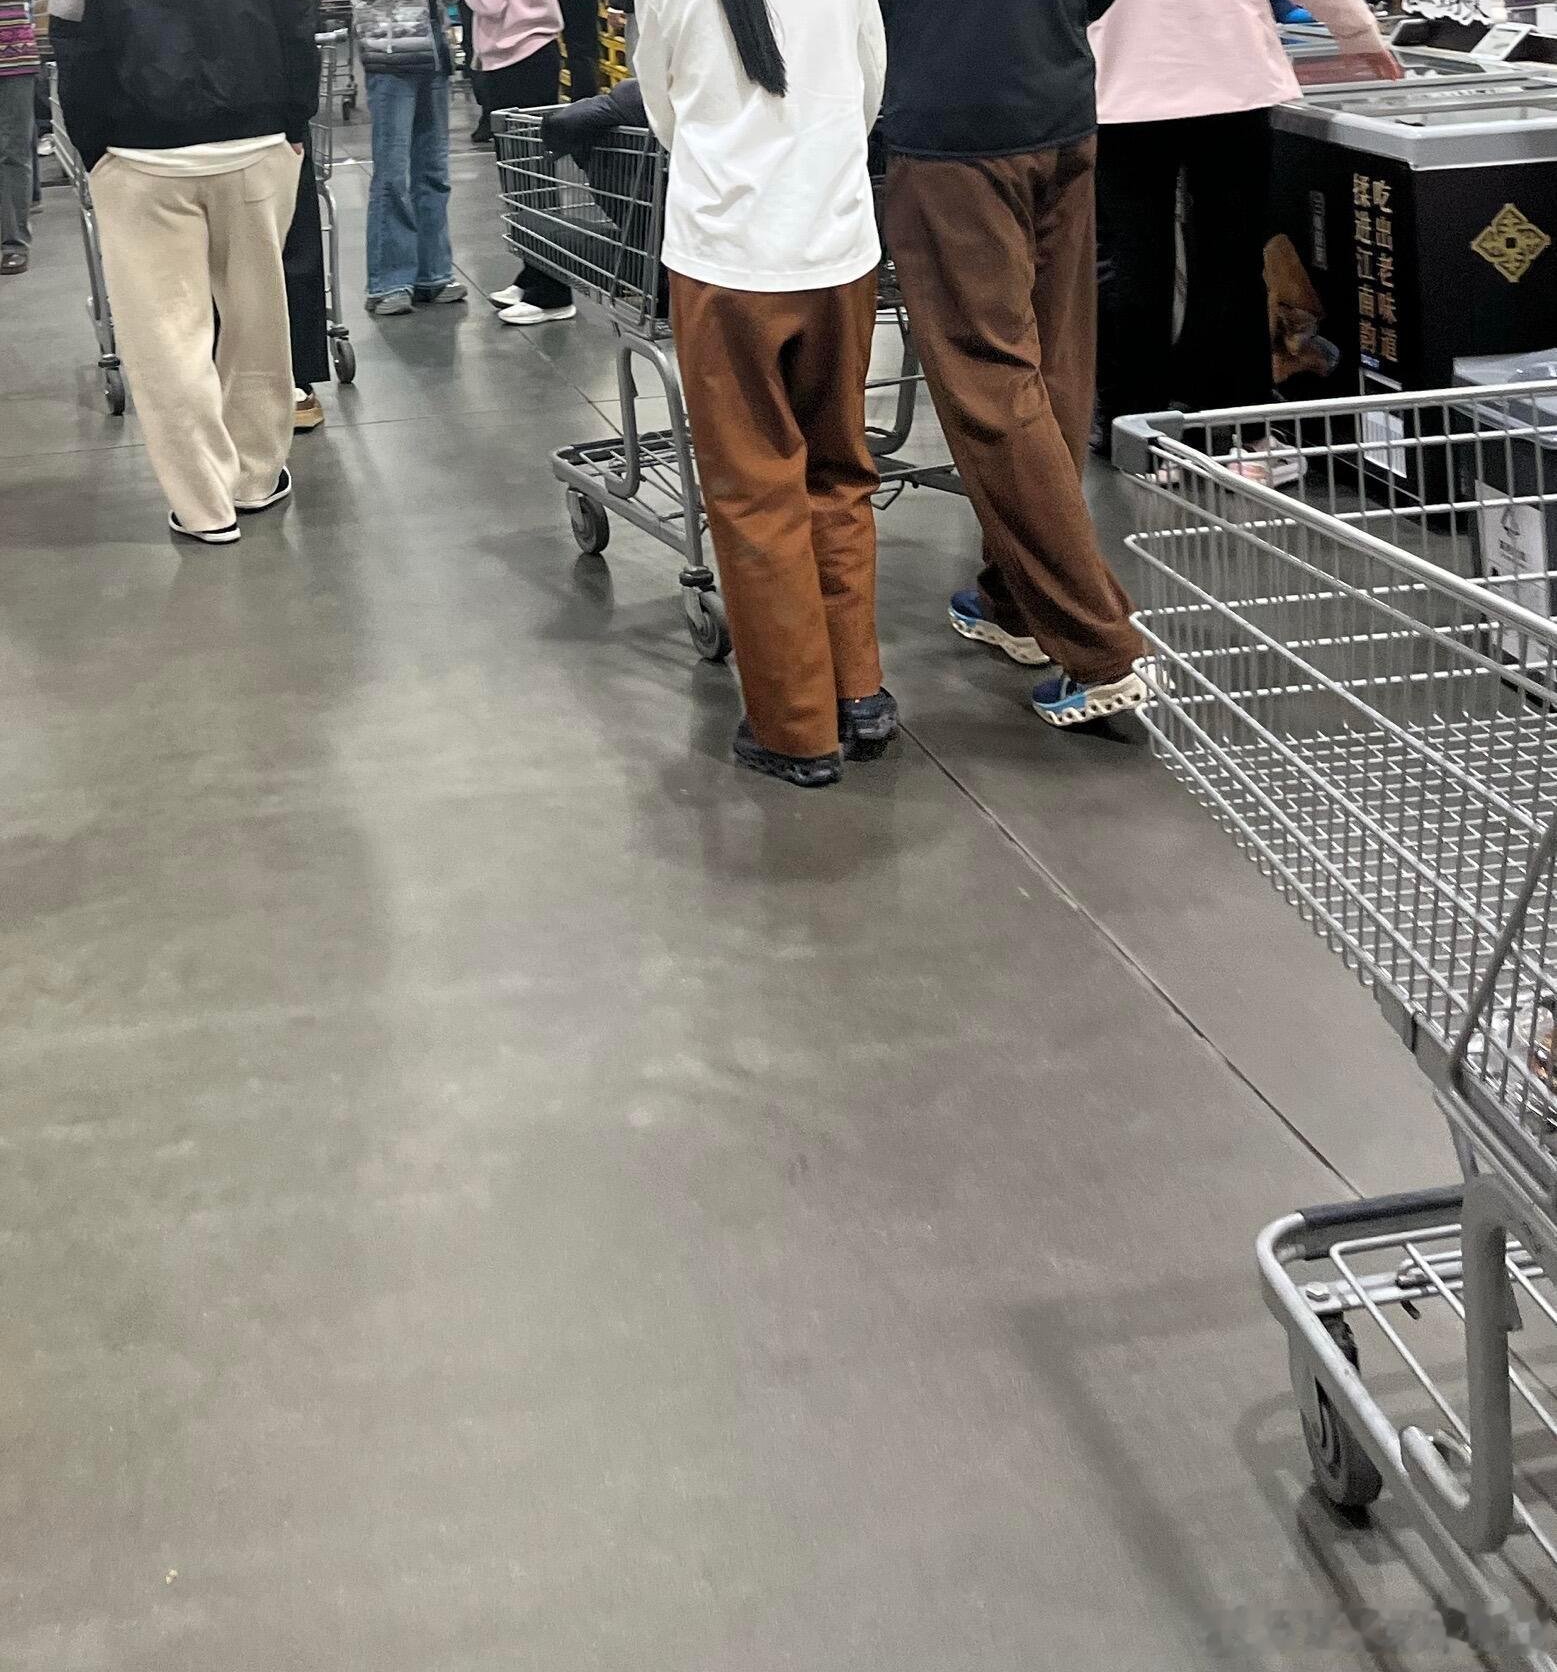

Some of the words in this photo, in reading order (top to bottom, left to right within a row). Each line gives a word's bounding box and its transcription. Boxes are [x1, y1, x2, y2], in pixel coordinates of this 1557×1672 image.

[1372, 180, 1398, 363] 吃出老味道
